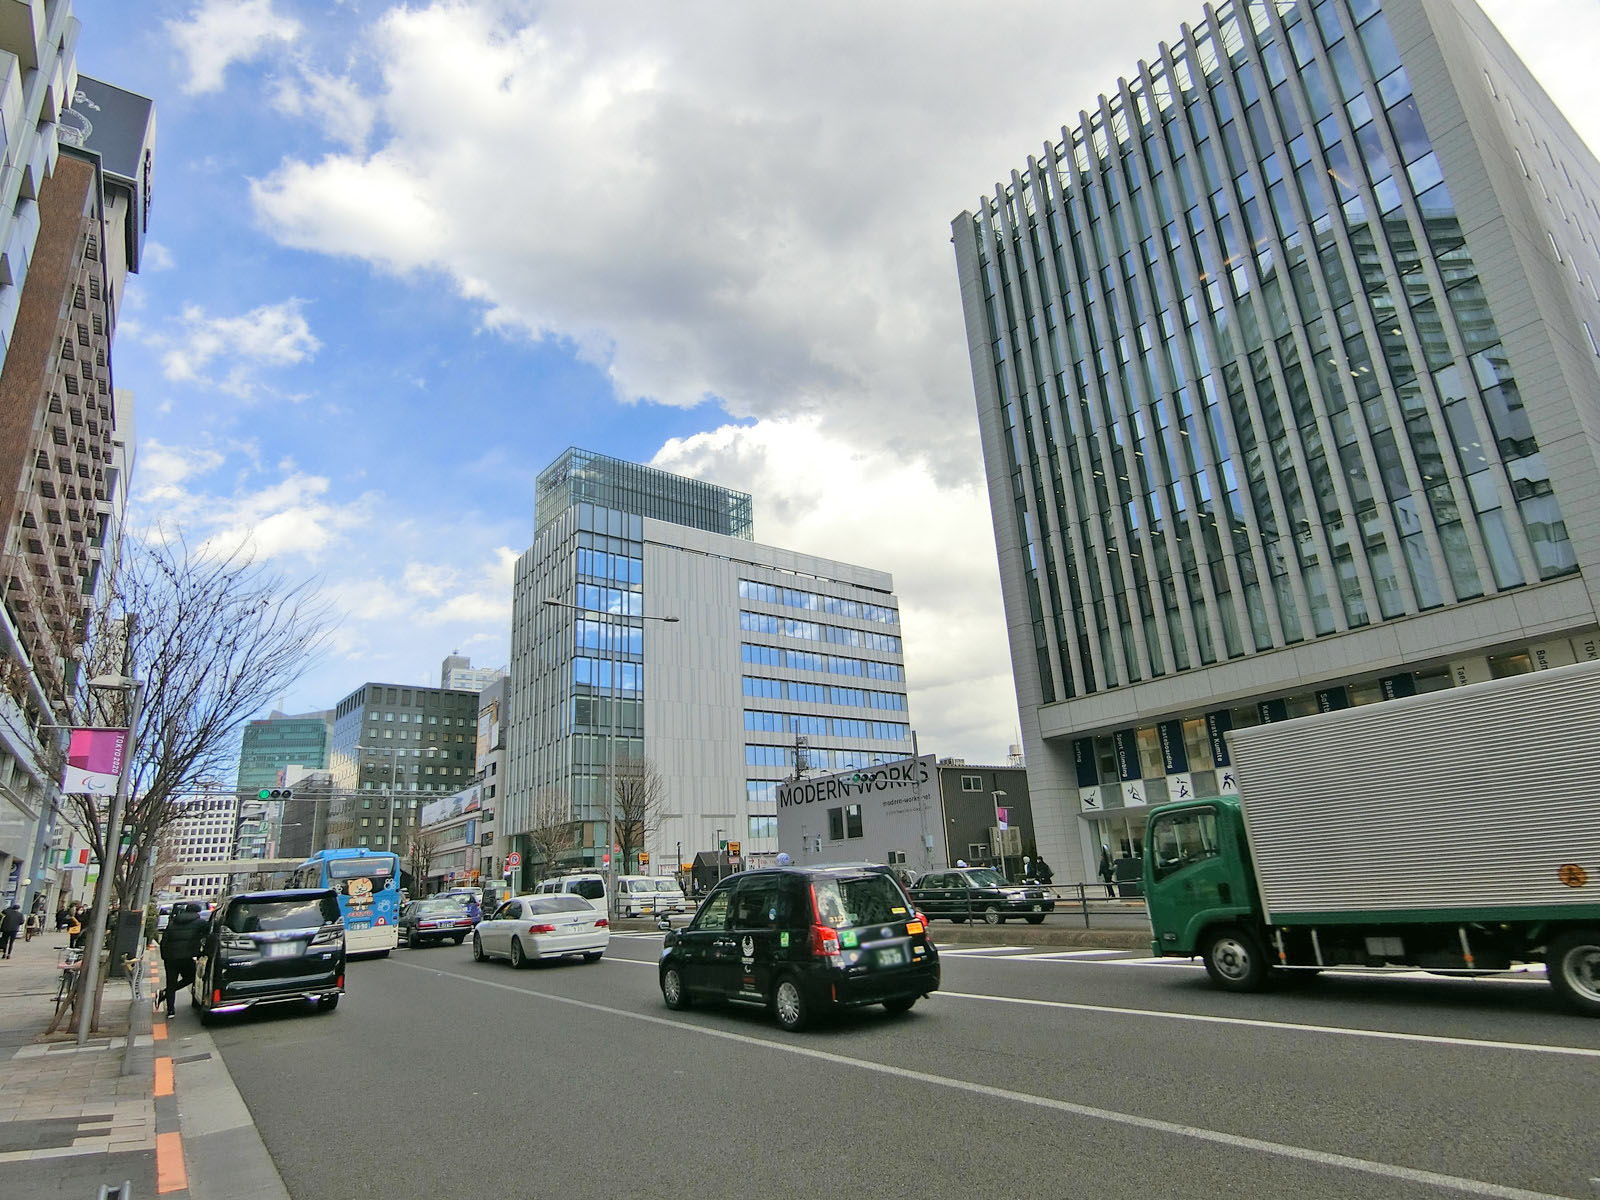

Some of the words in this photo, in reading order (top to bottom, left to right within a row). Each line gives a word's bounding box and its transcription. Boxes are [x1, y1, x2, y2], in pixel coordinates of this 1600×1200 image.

[1456, 665, 1467, 686] Taek
[1384, 680, 1395, 700] Base
[114, 735, 124, 756] TOKYO
[1160, 725, 1173, 769] Skateboarding
[1208, 715, 1217, 737] Karate
[1213, 738, 1222, 762] Kumite
[112, 757, 120, 774] 2020
[1120, 749, 1128, 778] Climbing
[780, 779, 850, 808] MODERN
